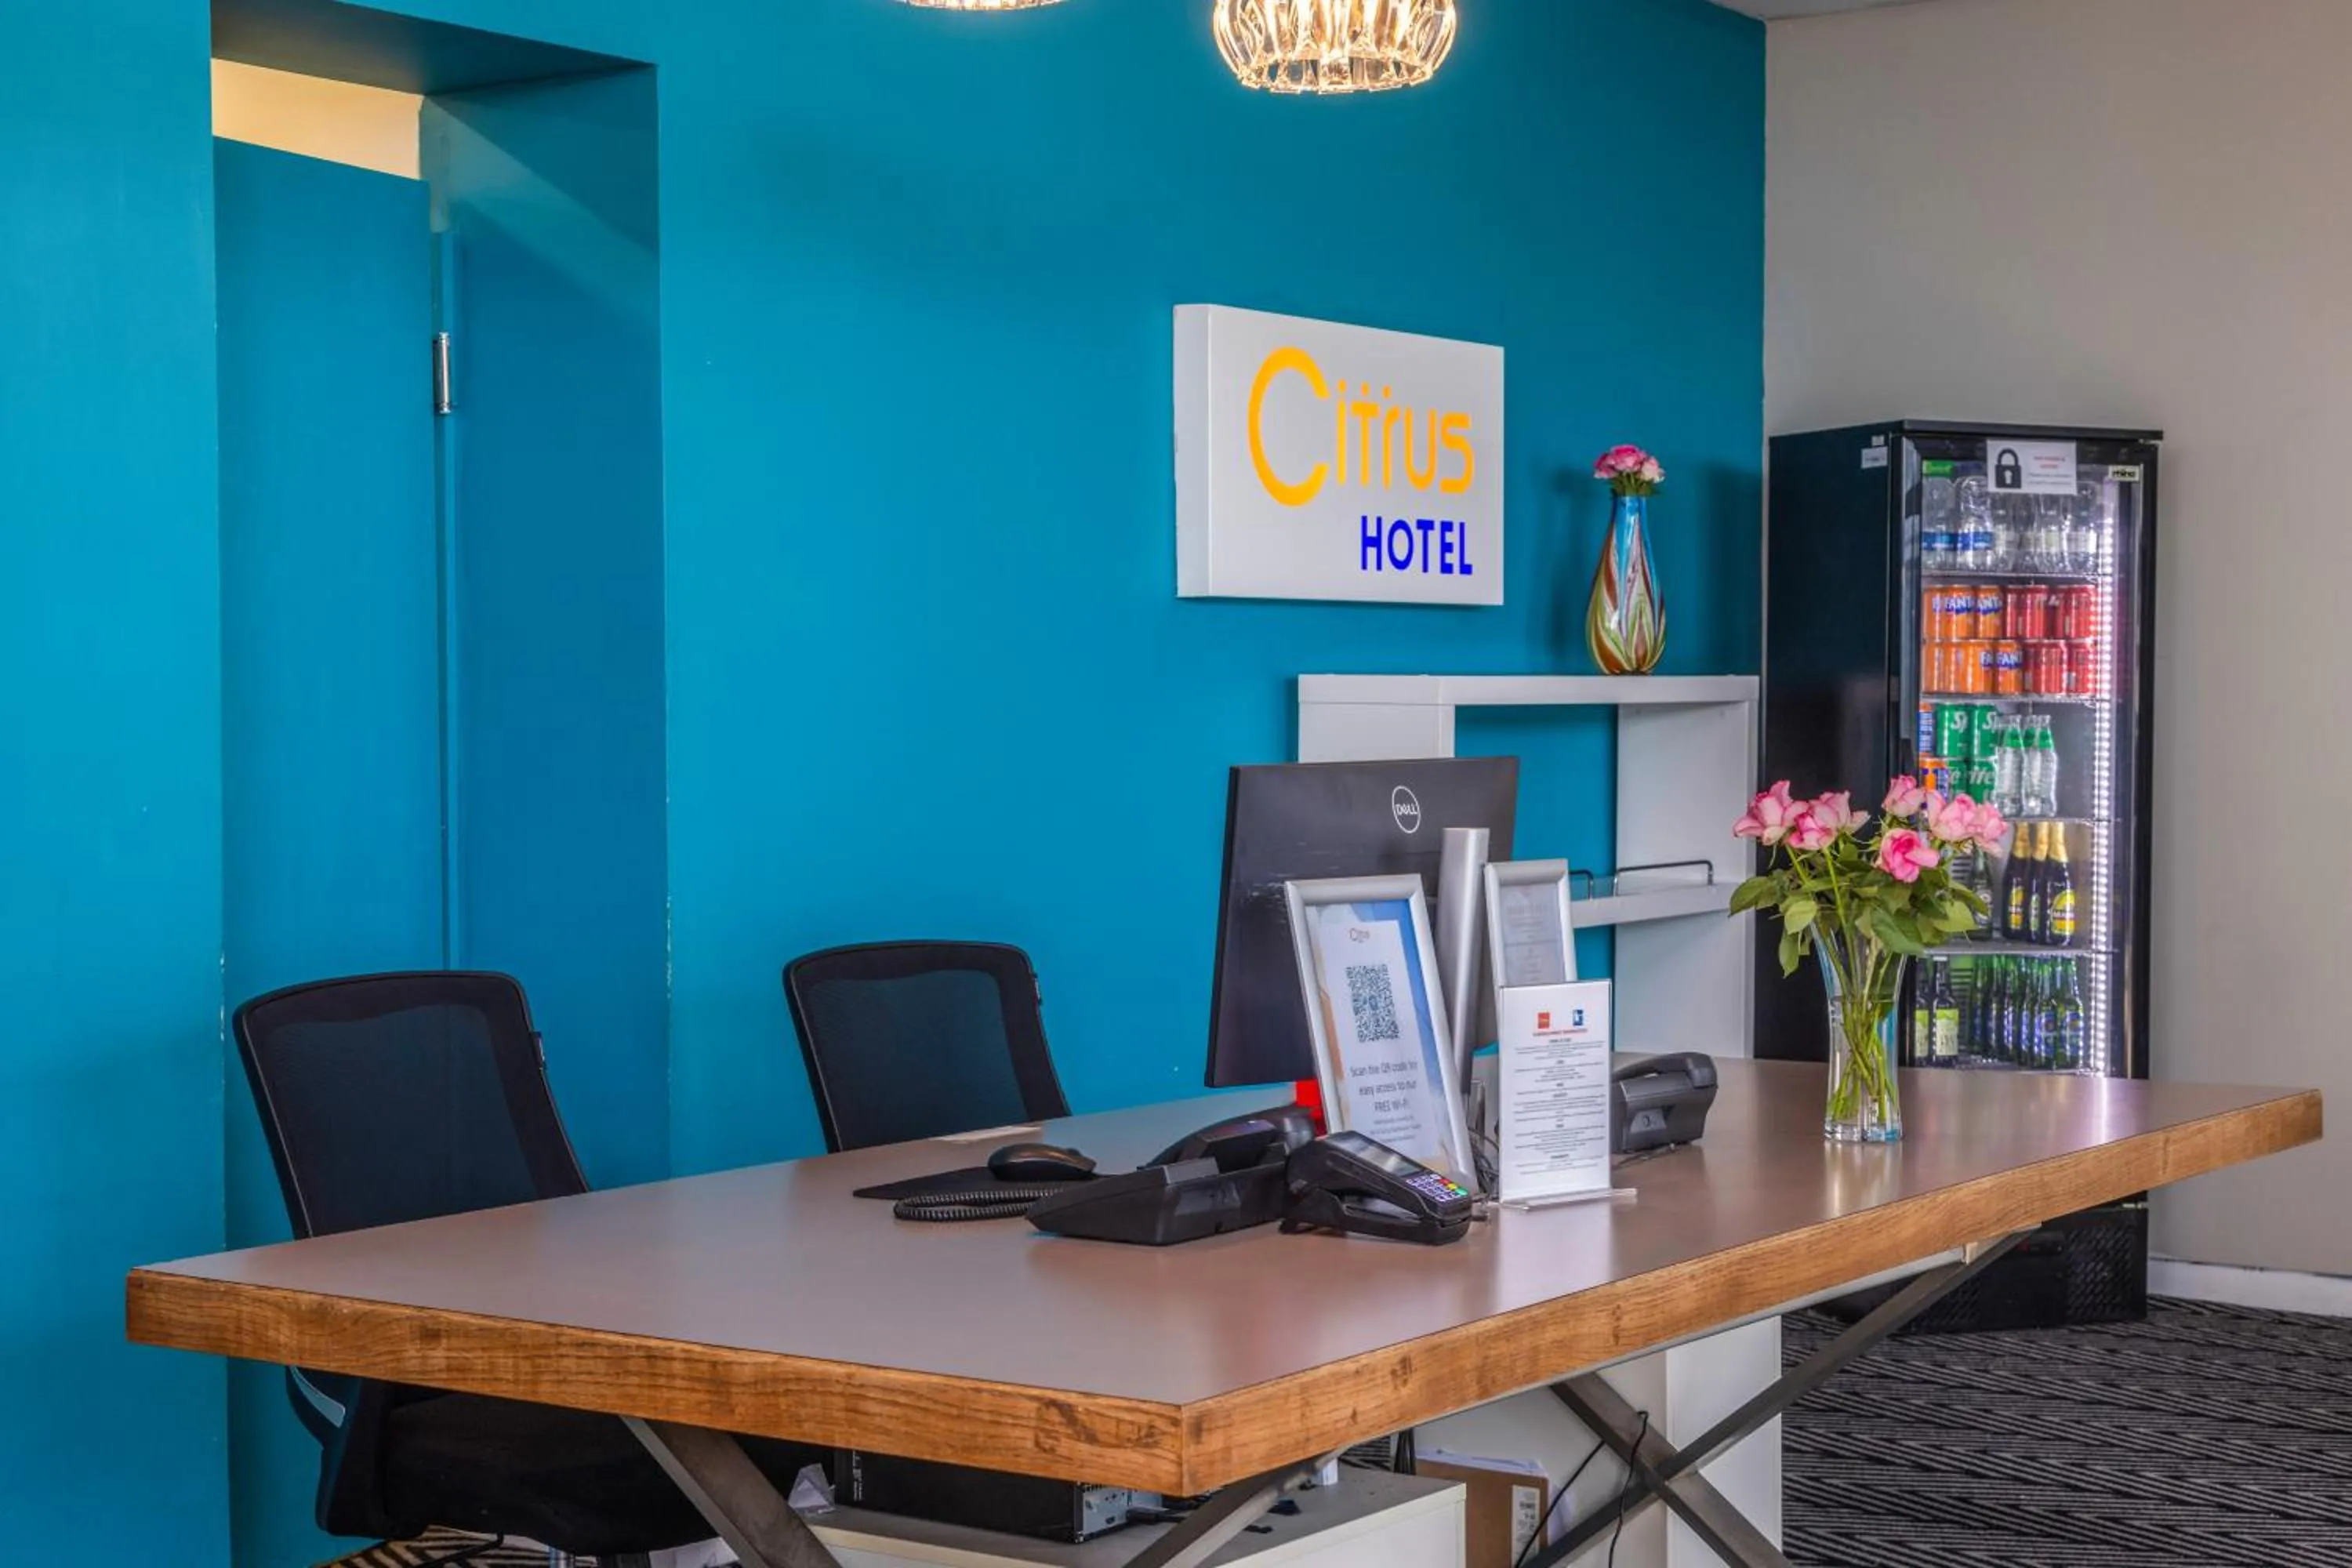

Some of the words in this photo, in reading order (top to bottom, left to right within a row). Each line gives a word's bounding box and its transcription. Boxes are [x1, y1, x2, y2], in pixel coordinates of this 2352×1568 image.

[1248, 346, 1475, 506] Citrus
[1360, 514, 1472, 575] HOTEL
[1396, 804, 1417, 815] DELL
[1374, 1101, 1391, 1112] FREE
